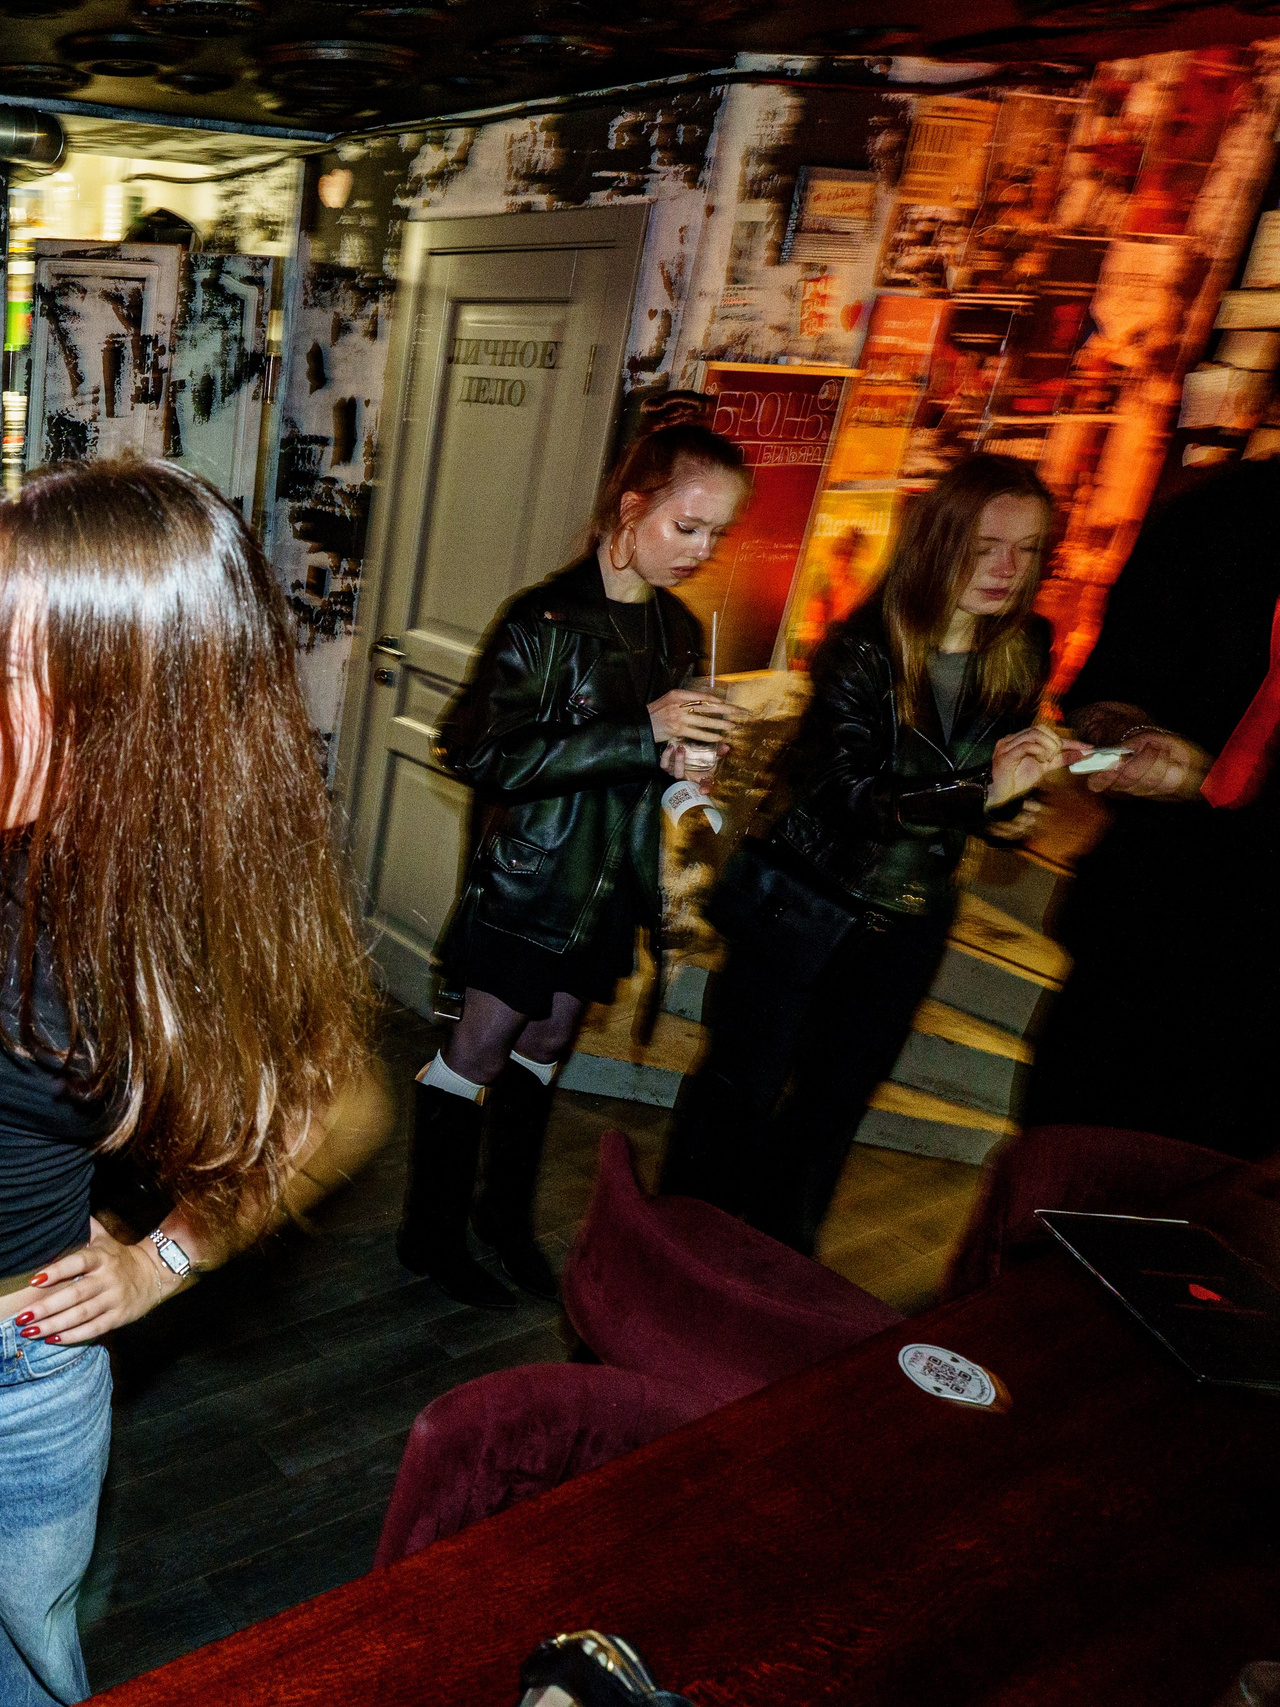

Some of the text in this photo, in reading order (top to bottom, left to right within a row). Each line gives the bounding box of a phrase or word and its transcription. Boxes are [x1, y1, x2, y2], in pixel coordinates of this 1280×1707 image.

[446, 338, 561, 370] ЛИЧНОЕ
[456, 376, 526, 407] ДЕЛО
[762, 445, 822, 464] БИЛЬЯРД
